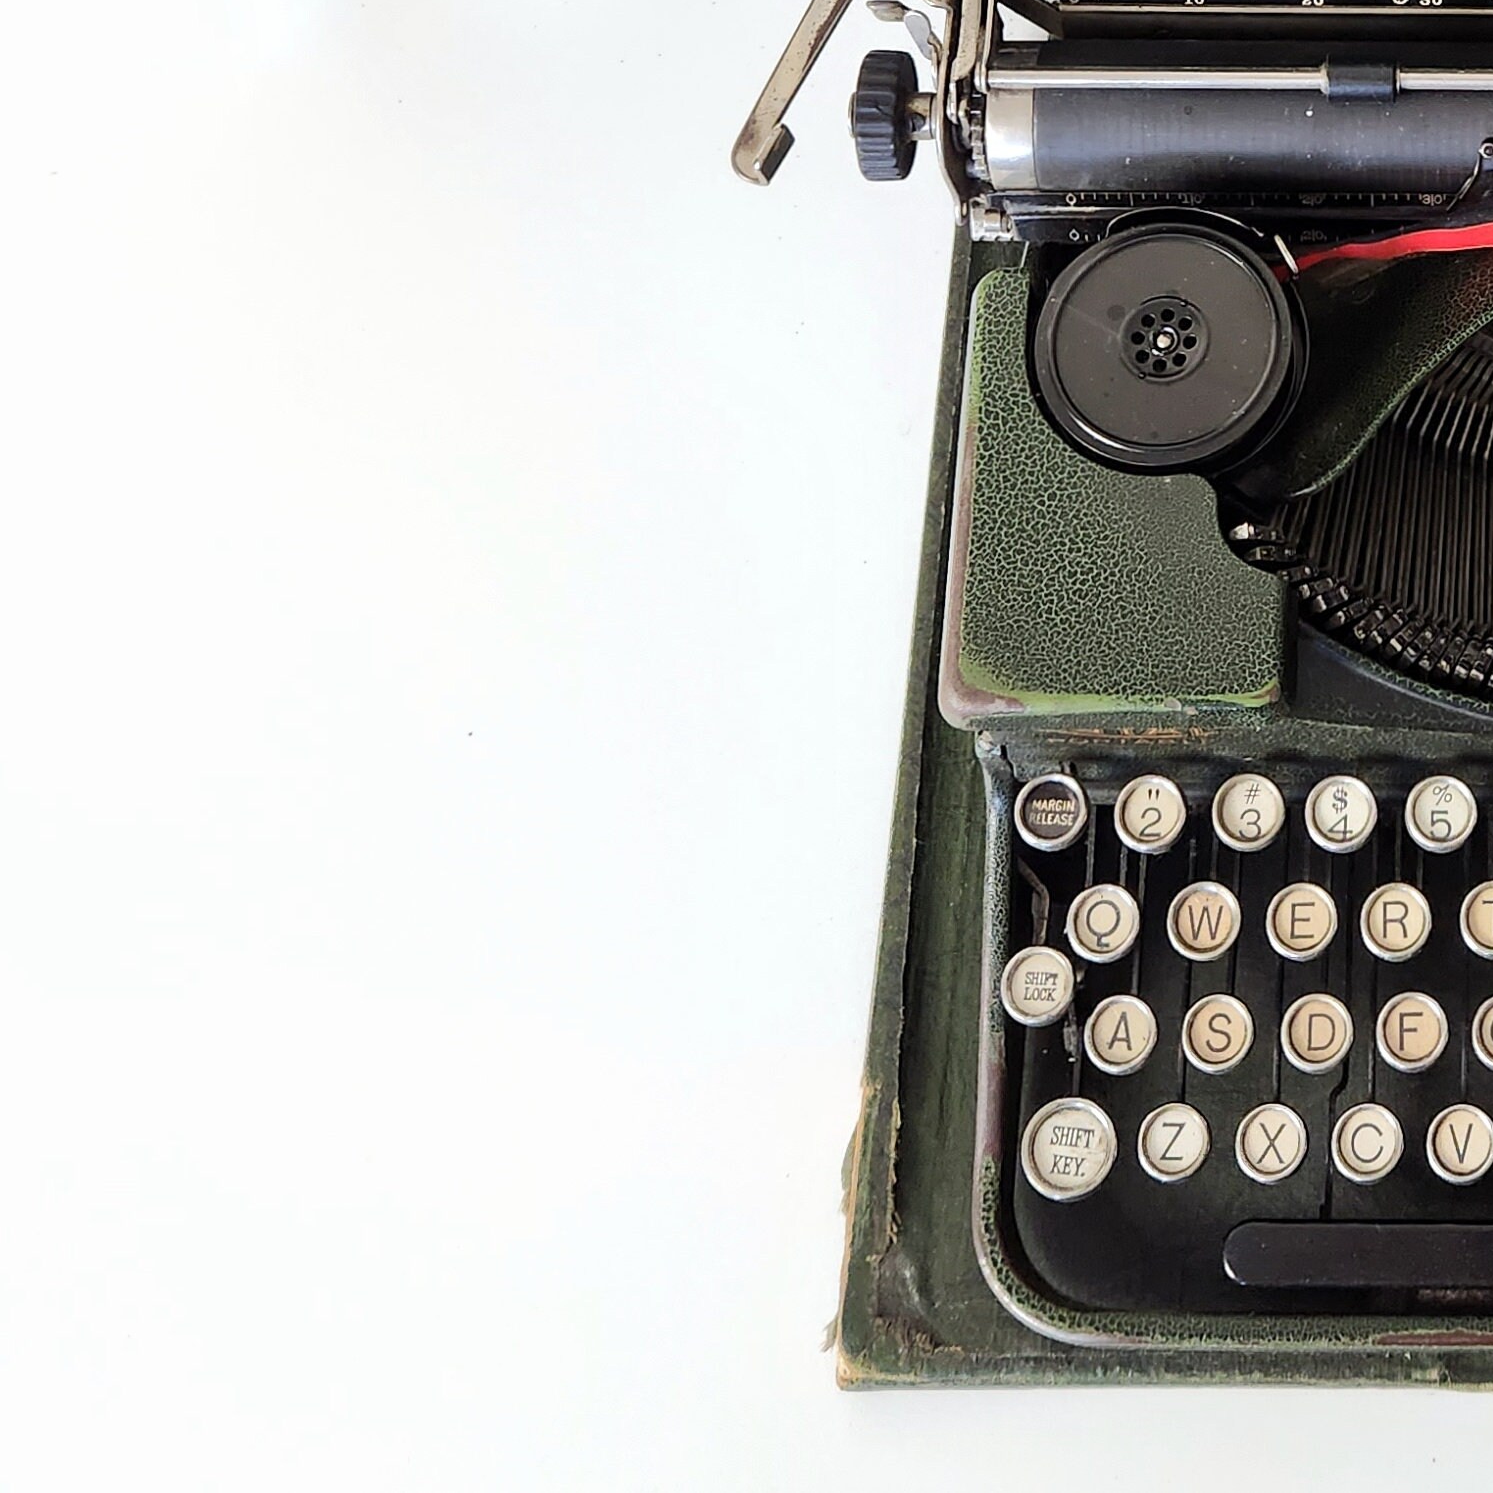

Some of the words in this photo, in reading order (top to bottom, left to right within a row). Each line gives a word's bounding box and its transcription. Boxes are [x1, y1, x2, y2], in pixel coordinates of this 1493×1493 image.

[1421, 193, 1443, 206] 30
[1032, 799, 1076, 810] MARGIN
[1243, 782, 1261, 804] #
[1331, 786, 1348, 814] $
[1432, 784, 1453, 806] %
[1030, 811, 1075, 827] RELEASE
[1139, 807, 1162, 838] 2
[1238, 808, 1262, 841] 3
[1326, 815, 1354, 843] 4
[1429, 810, 1451, 839] 5
[1085, 899, 1121, 948] Q
[1188, 904, 1224, 941] W
[1289, 901, 1316, 940] E
[1382, 900, 1409, 939] R
[1023, 986, 1057, 1002] LOCK
[1024, 971, 1059, 986] SHIFT
[1107, 1010, 1132, 1051] A
[1205, 1012, 1232, 1053] S
[1306, 1013, 1336, 1051] D
[1398, 1011, 1424, 1052] F
[1049, 1125, 1095, 1149] SHIFT
[1159, 1122, 1186, 1161] Z
[1256, 1122, 1286, 1165] X
[1350, 1123, 1385, 1164] C
[1449, 1123, 1473, 1164] V
